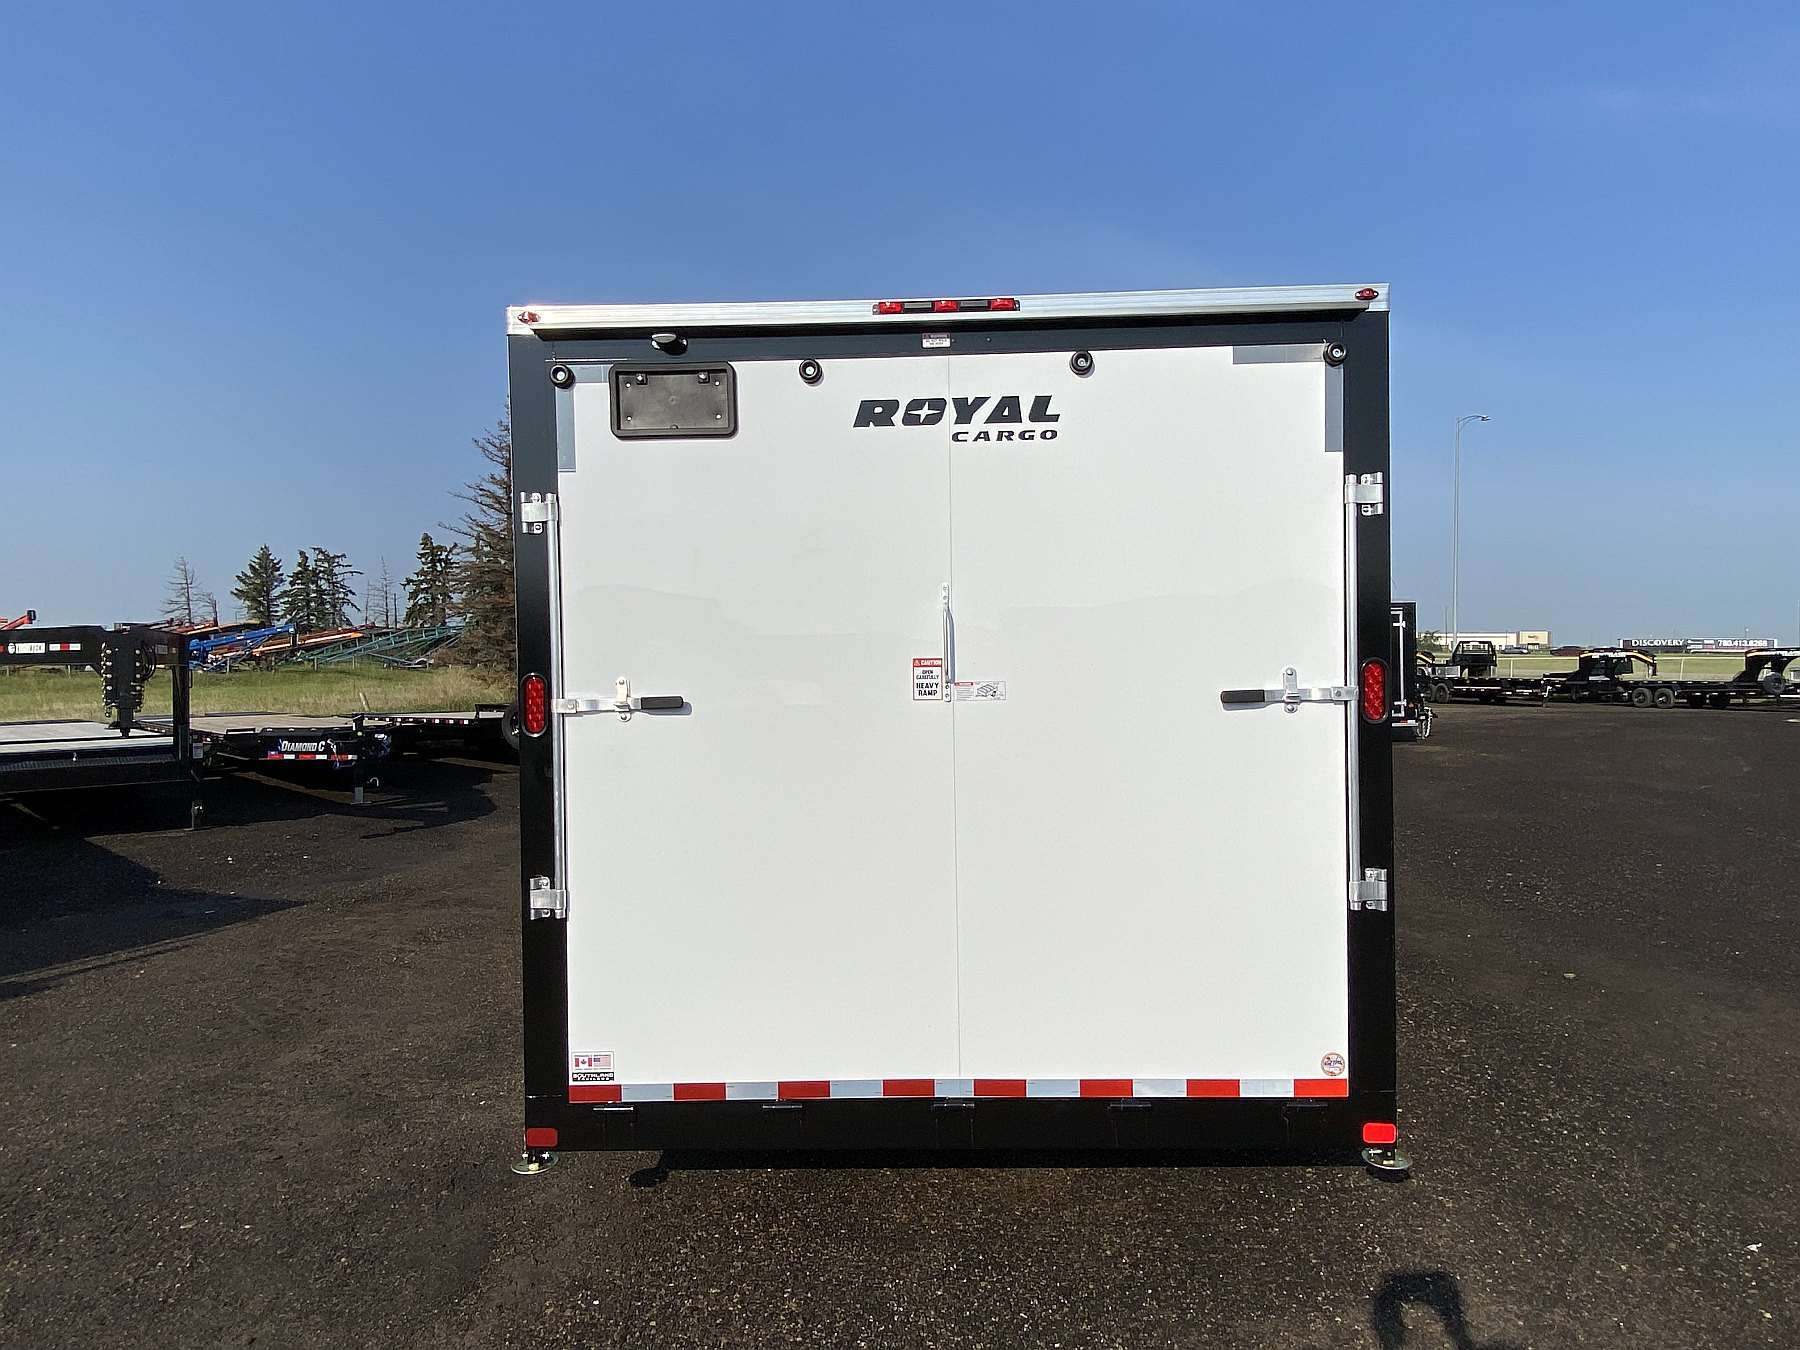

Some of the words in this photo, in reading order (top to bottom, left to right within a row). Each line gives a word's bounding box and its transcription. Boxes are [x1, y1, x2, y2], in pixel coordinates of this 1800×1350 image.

[853, 395, 1060, 427] ROYAL
[951, 429, 1058, 442] CARGO
[1632, 639, 1684, 647] DISCOVERY
[281, 741, 317, 751] DIAMOND
[318, 741, 325, 751] C
